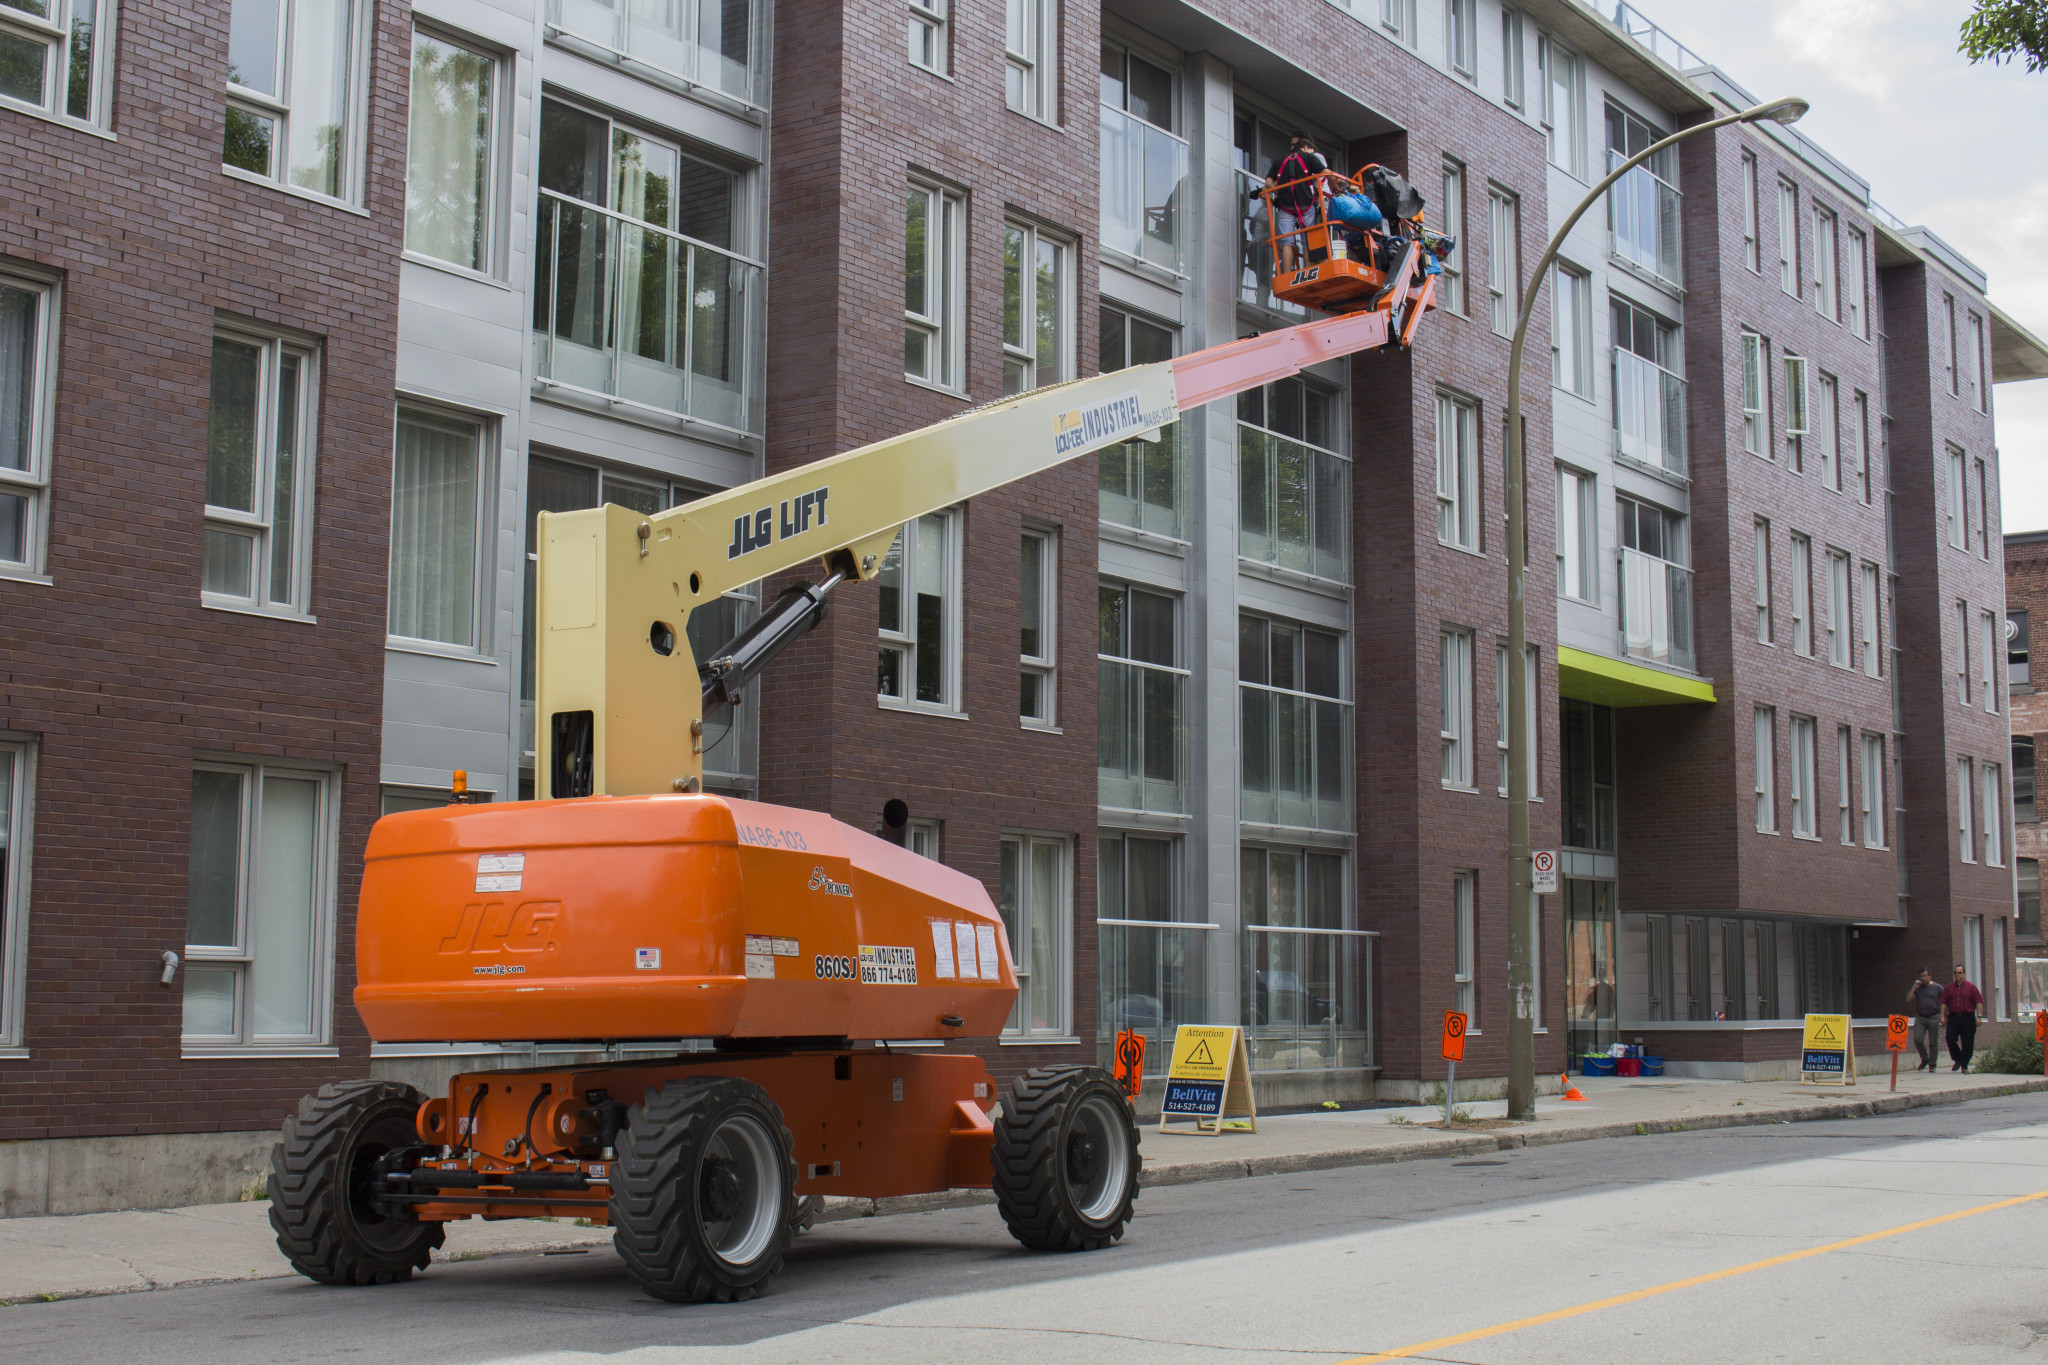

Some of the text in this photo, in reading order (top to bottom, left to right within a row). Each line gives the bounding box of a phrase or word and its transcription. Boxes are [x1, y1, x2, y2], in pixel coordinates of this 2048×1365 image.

[1290, 266, 1319, 286] JLG
[1055, 396, 1143, 454] LOU-TEC INDUSTRIEL
[1143, 406, 1173, 427] NA86-103
[728, 485, 829, 561] JLG LIFT
[736, 824, 807, 850] NA86-103
[438, 900, 562, 955] JLG
[874, 947, 915, 965] INDUSTRIEL
[473, 964, 525, 975] www.jlg.com
[815, 954, 857, 980] 860SJ
[861, 966, 917, 983] 866 774-4188
[1186, 1028, 1224, 1038] Attention
[1807, 1055, 1840, 1064] BellVitt
[1171, 1087, 1216, 1101] BellVitt
[1168, 1101, 1216, 1111] 514-527-4189
